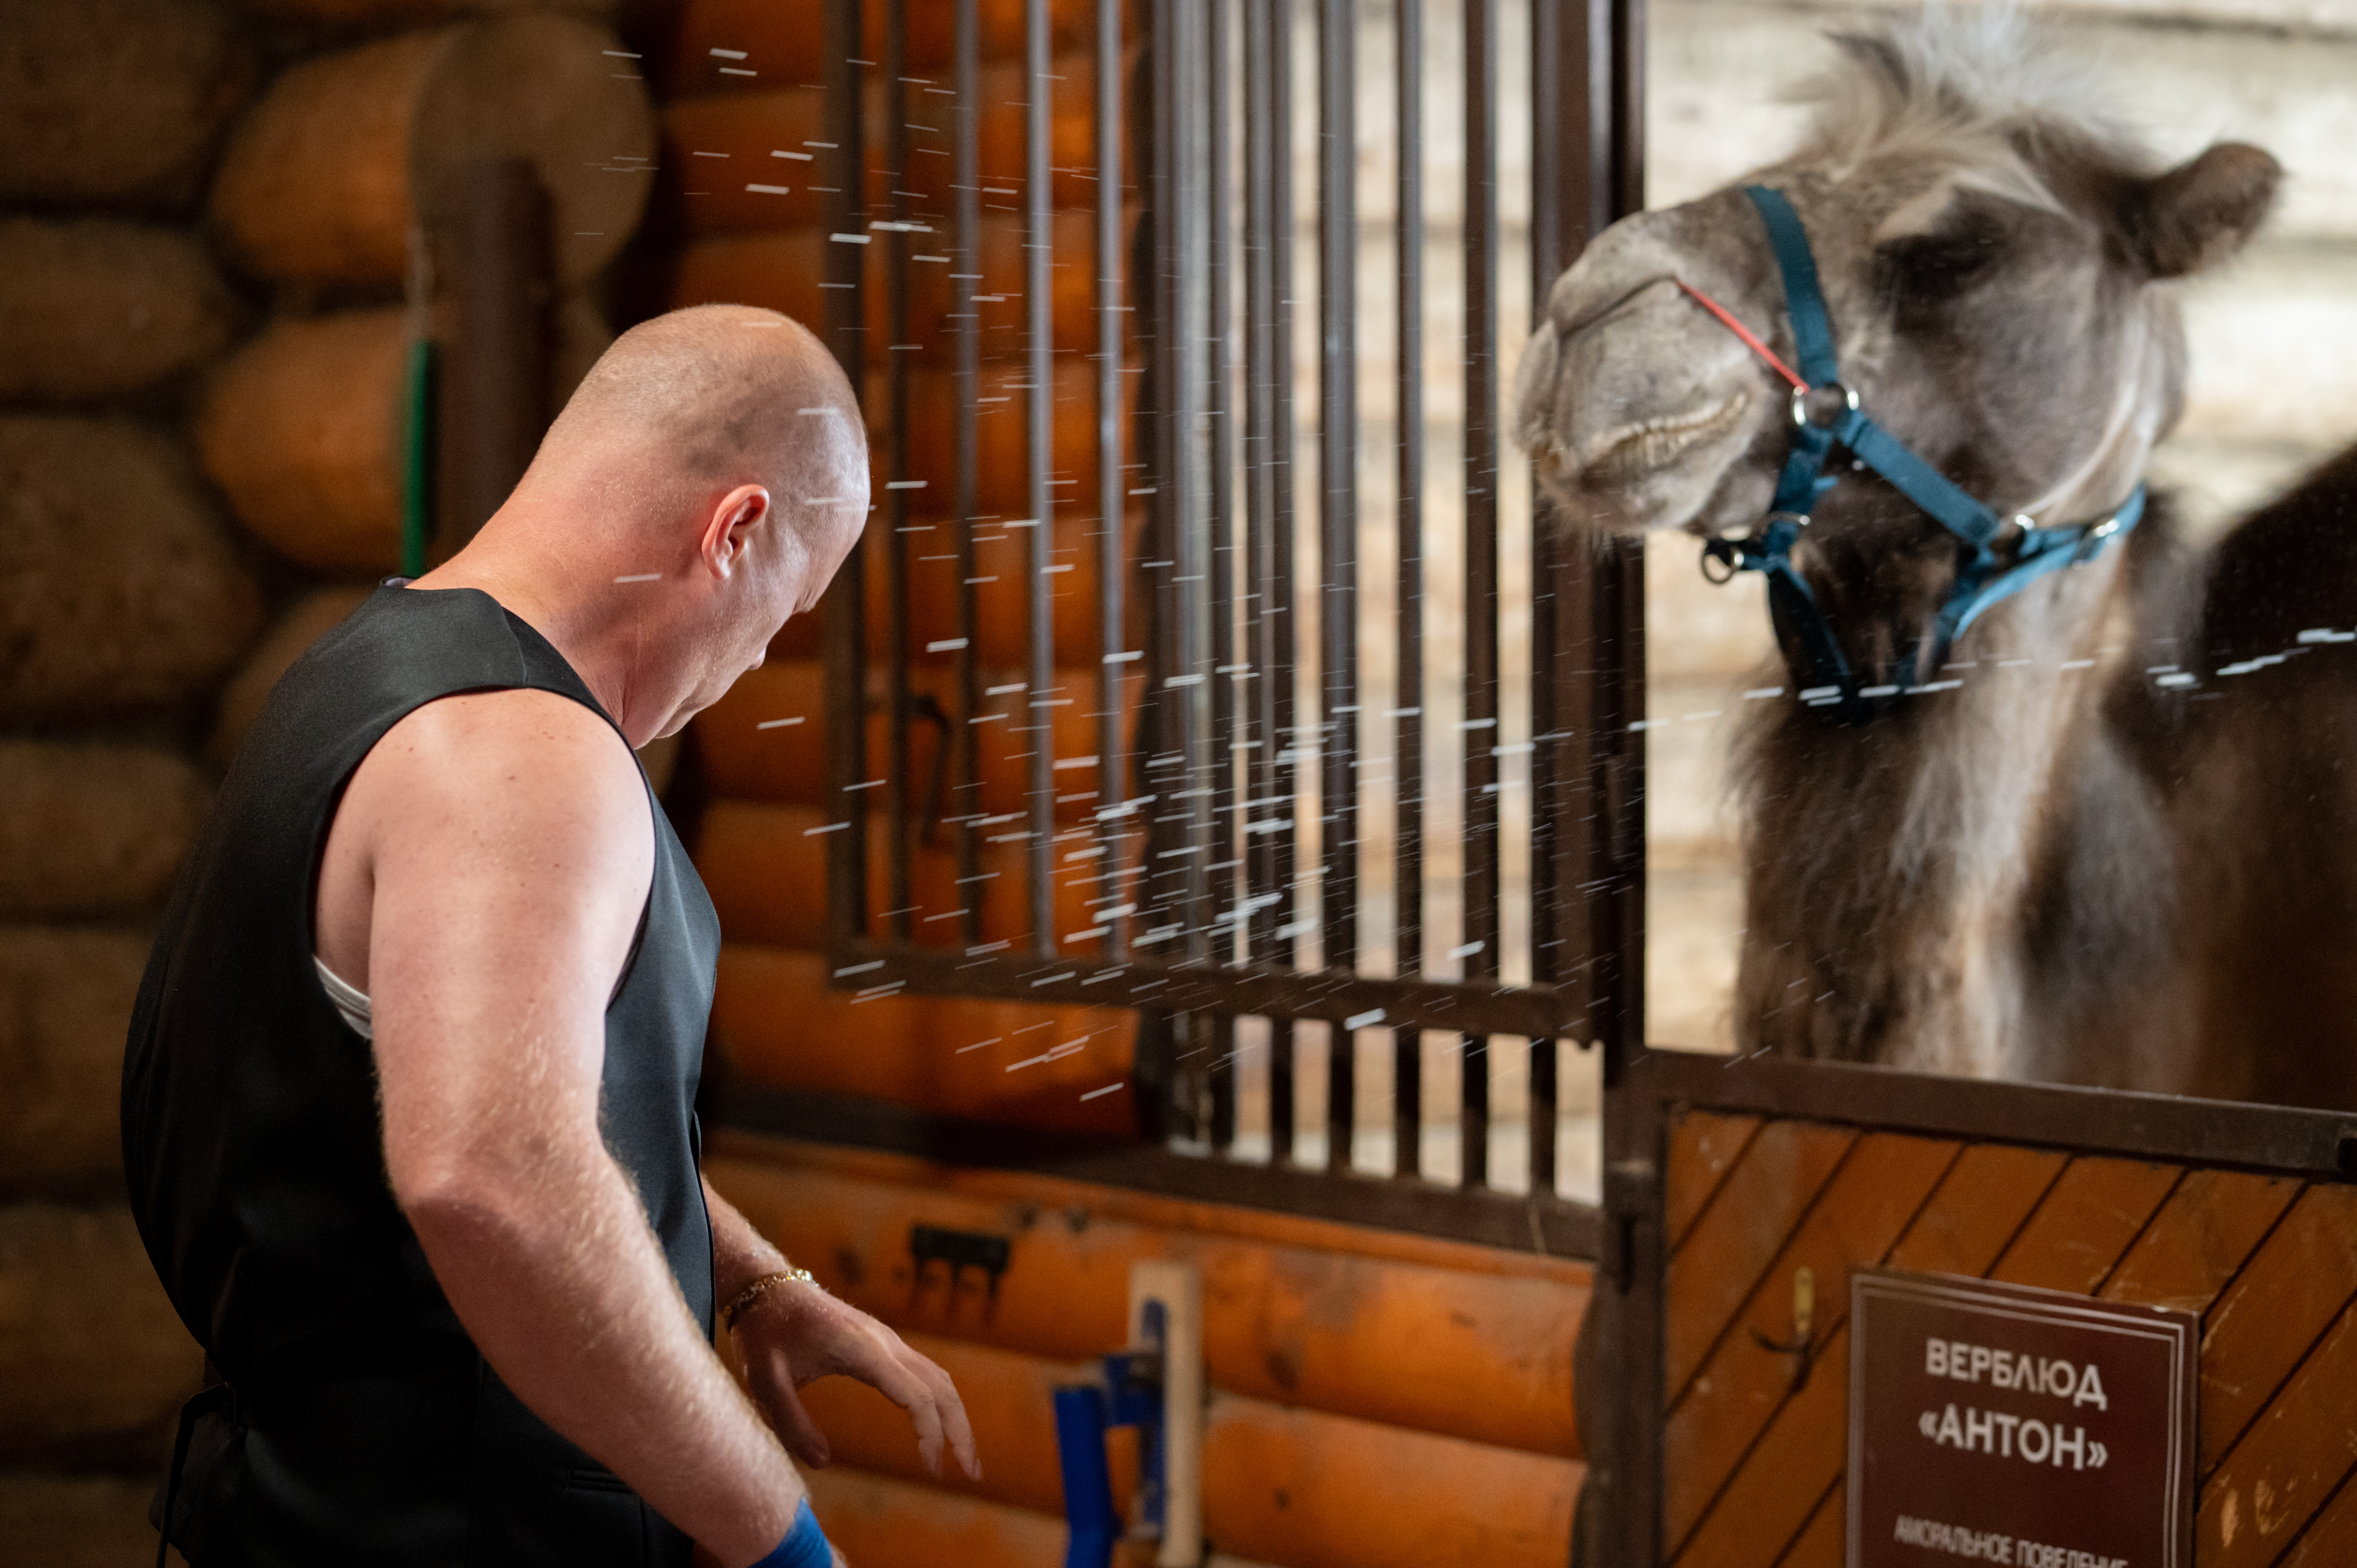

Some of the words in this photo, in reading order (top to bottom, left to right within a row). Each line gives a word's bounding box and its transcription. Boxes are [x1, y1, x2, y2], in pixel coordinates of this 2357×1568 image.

[1925, 1337, 2108, 1411] ВЕРБЛЮД
[1918, 1404, 2108, 1471] «АНТОН»
[2016, 1539, 2129, 1568] ПОВЕДЕ
